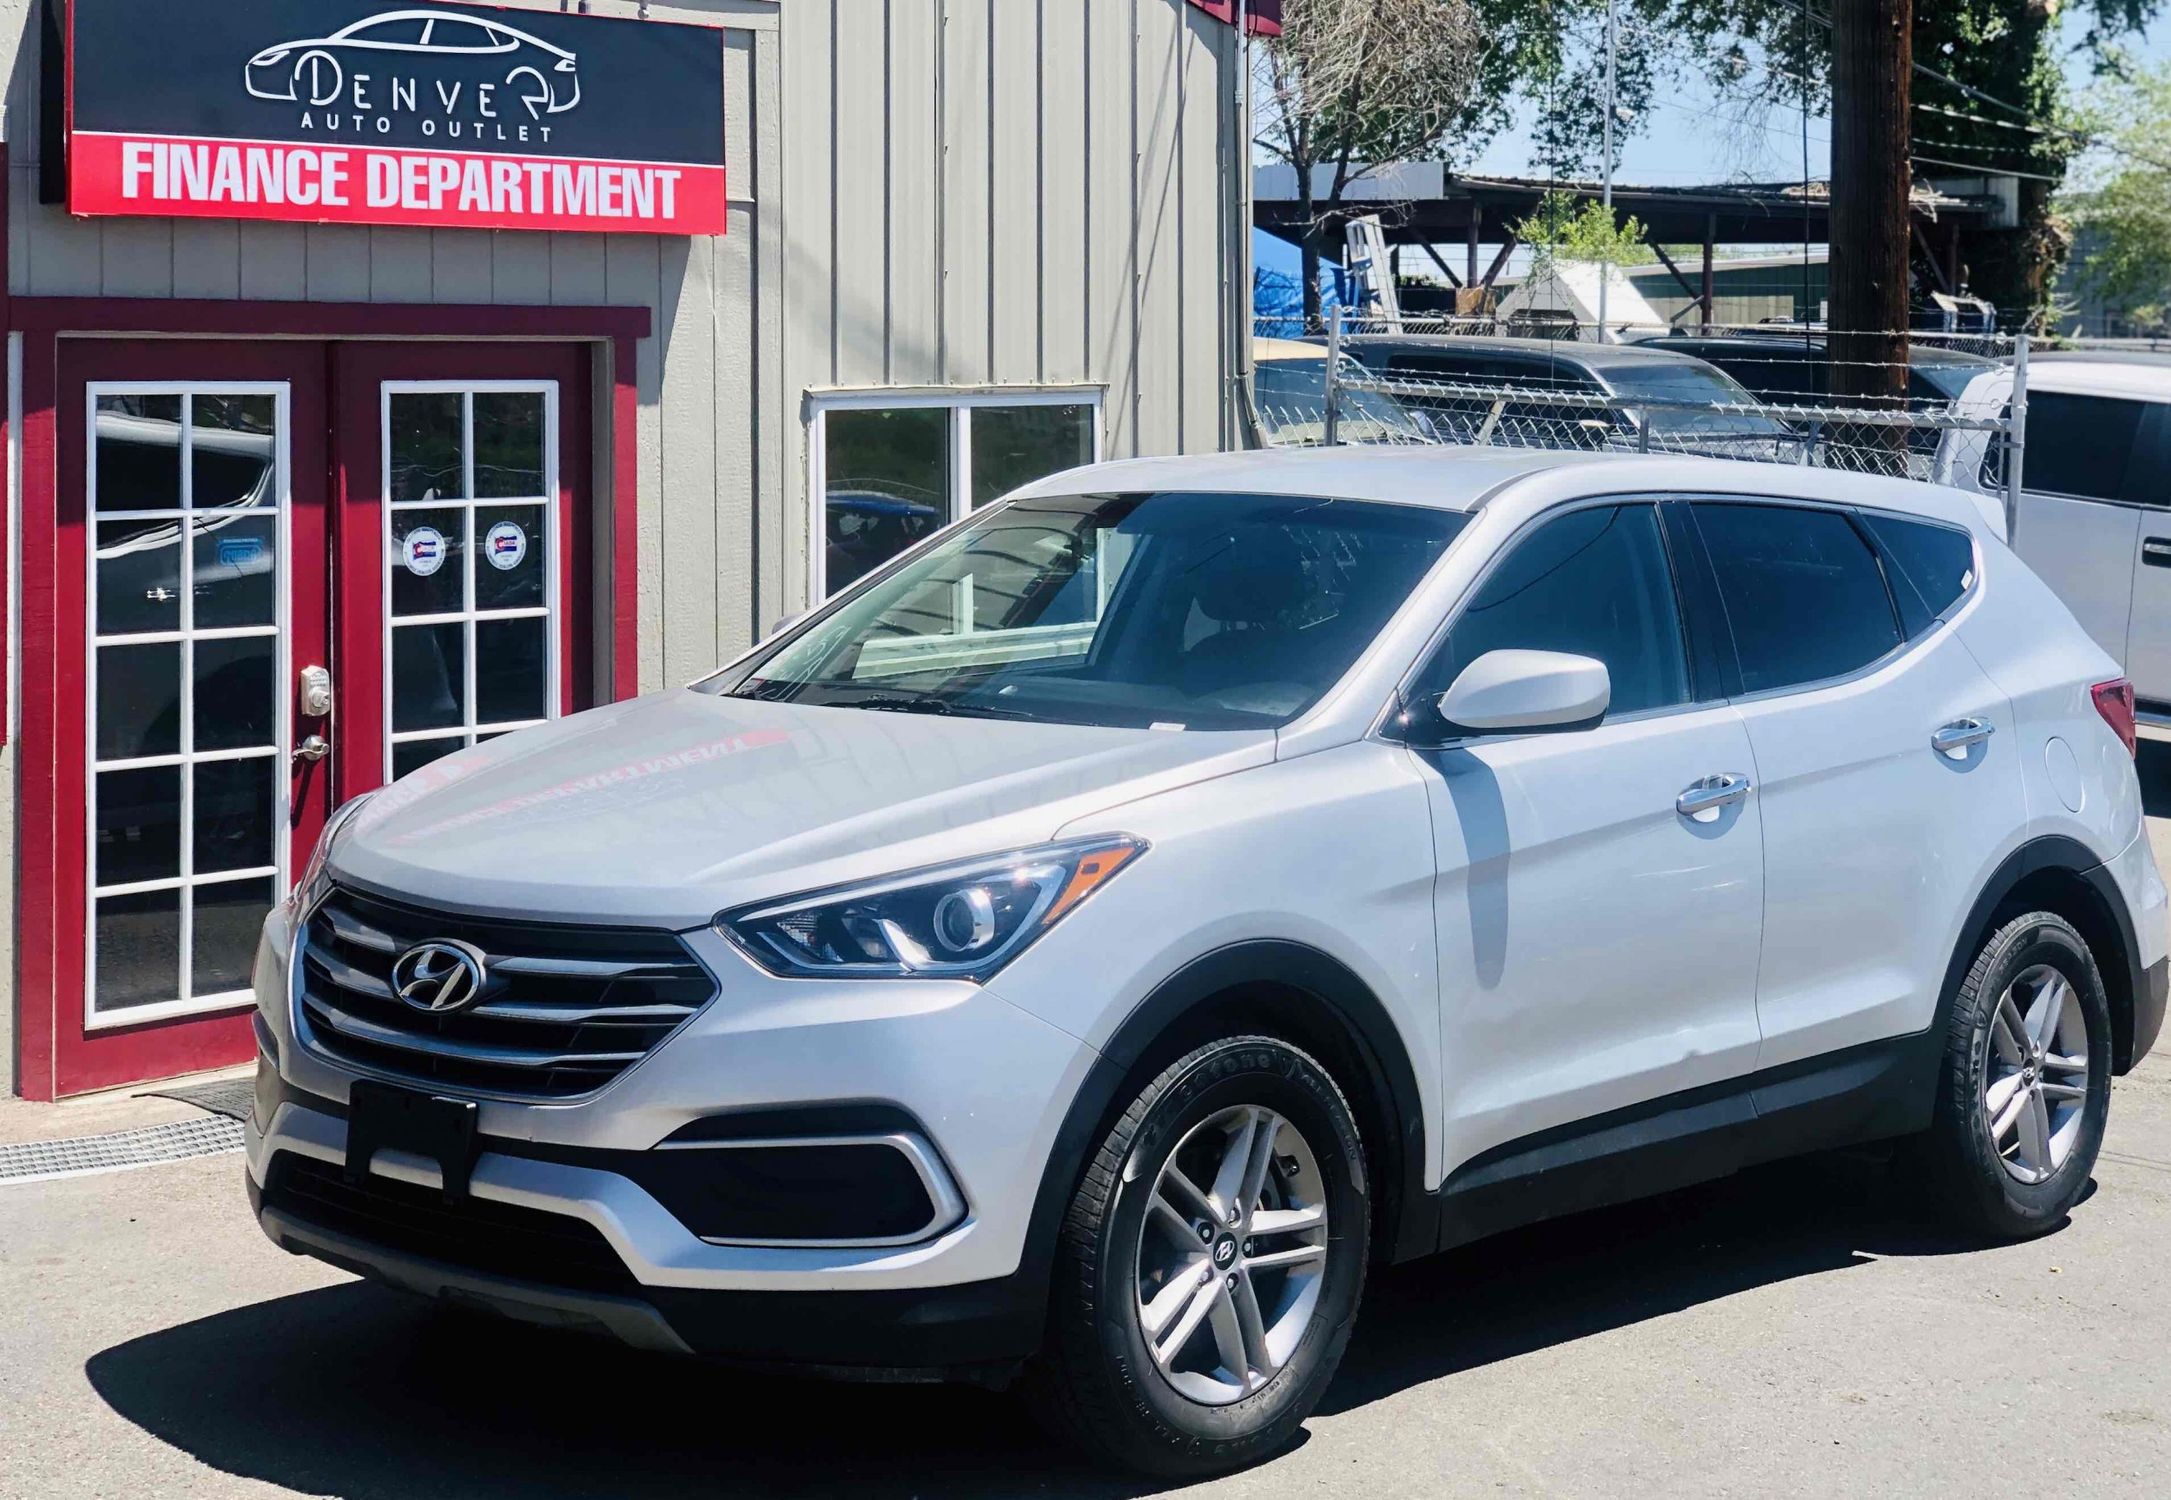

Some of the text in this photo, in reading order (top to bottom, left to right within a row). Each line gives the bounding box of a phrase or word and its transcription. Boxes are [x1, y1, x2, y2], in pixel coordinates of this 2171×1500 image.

[294, 49, 549, 120] DENVER
[300, 112, 551, 142] AUTO OUTLET
[122, 141, 681, 219] FINANCE DEPARTMENT
